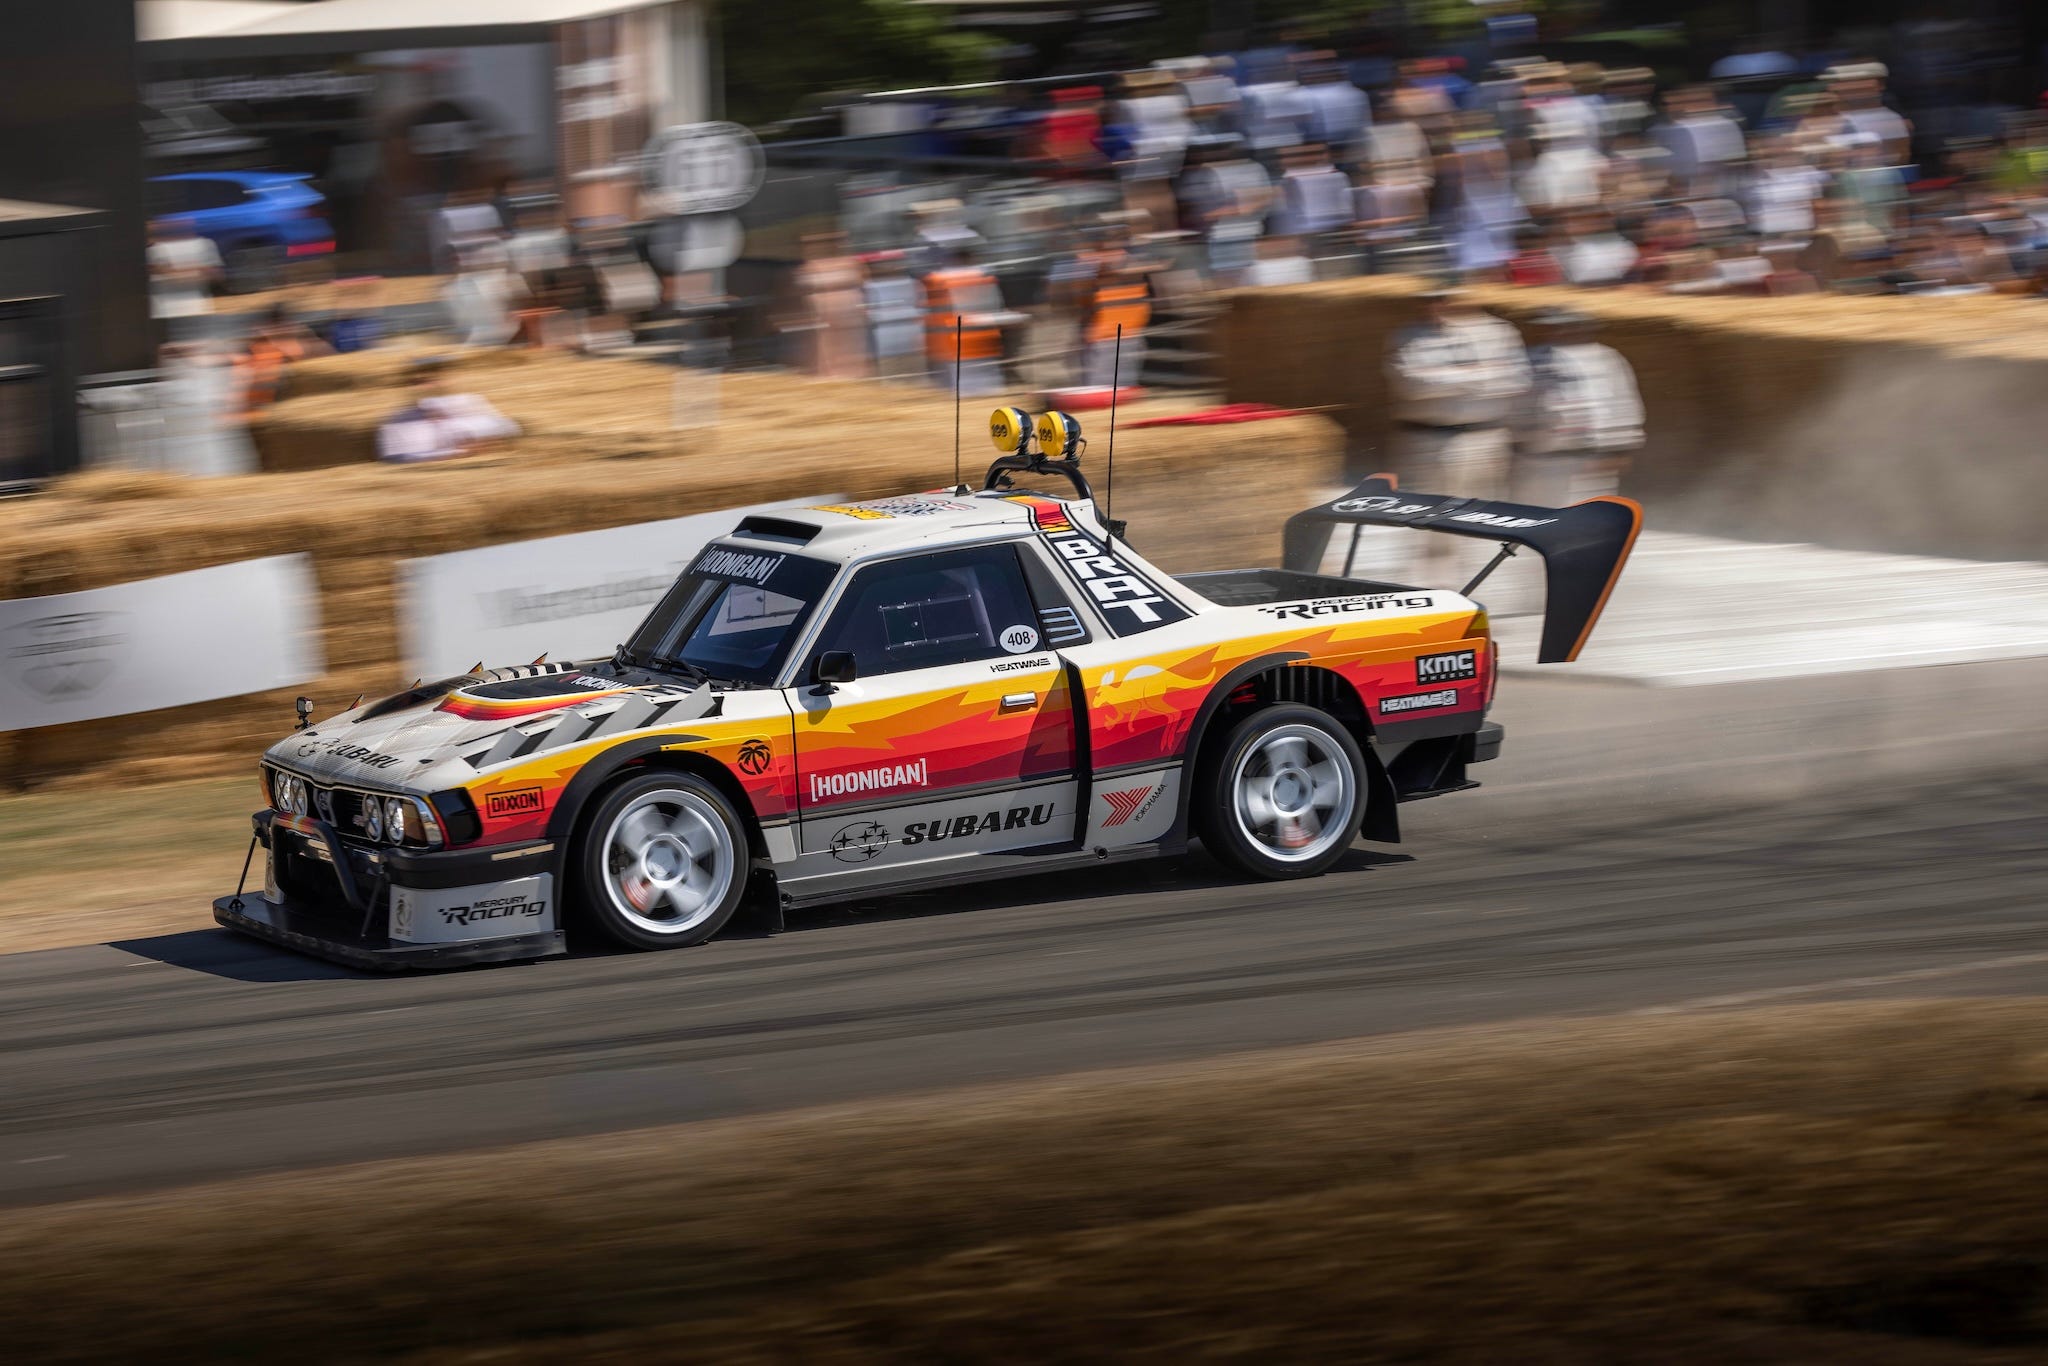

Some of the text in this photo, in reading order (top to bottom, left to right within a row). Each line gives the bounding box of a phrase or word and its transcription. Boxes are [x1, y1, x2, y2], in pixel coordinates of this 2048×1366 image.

[690, 545, 786, 585] [HOONIGAN]
[1053, 538, 1164, 623] BRAT
[1274, 597, 1433, 620] Racing
[1312, 594, 1396, 606] MERCURY
[1007, 631, 1031, 646] 408
[990, 658, 1051, 672] HEATWAVE
[327, 744, 404, 769] SUBARU
[810, 758, 928, 802] [HOONIGAN]
[492, 791, 540, 814] DIXXON
[1133, 783, 1168, 823] YOKOHAMA
[902, 802, 1055, 846] SUBARU
[445, 901, 546, 925] Racing
[473, 895, 528, 909] MERCURY
